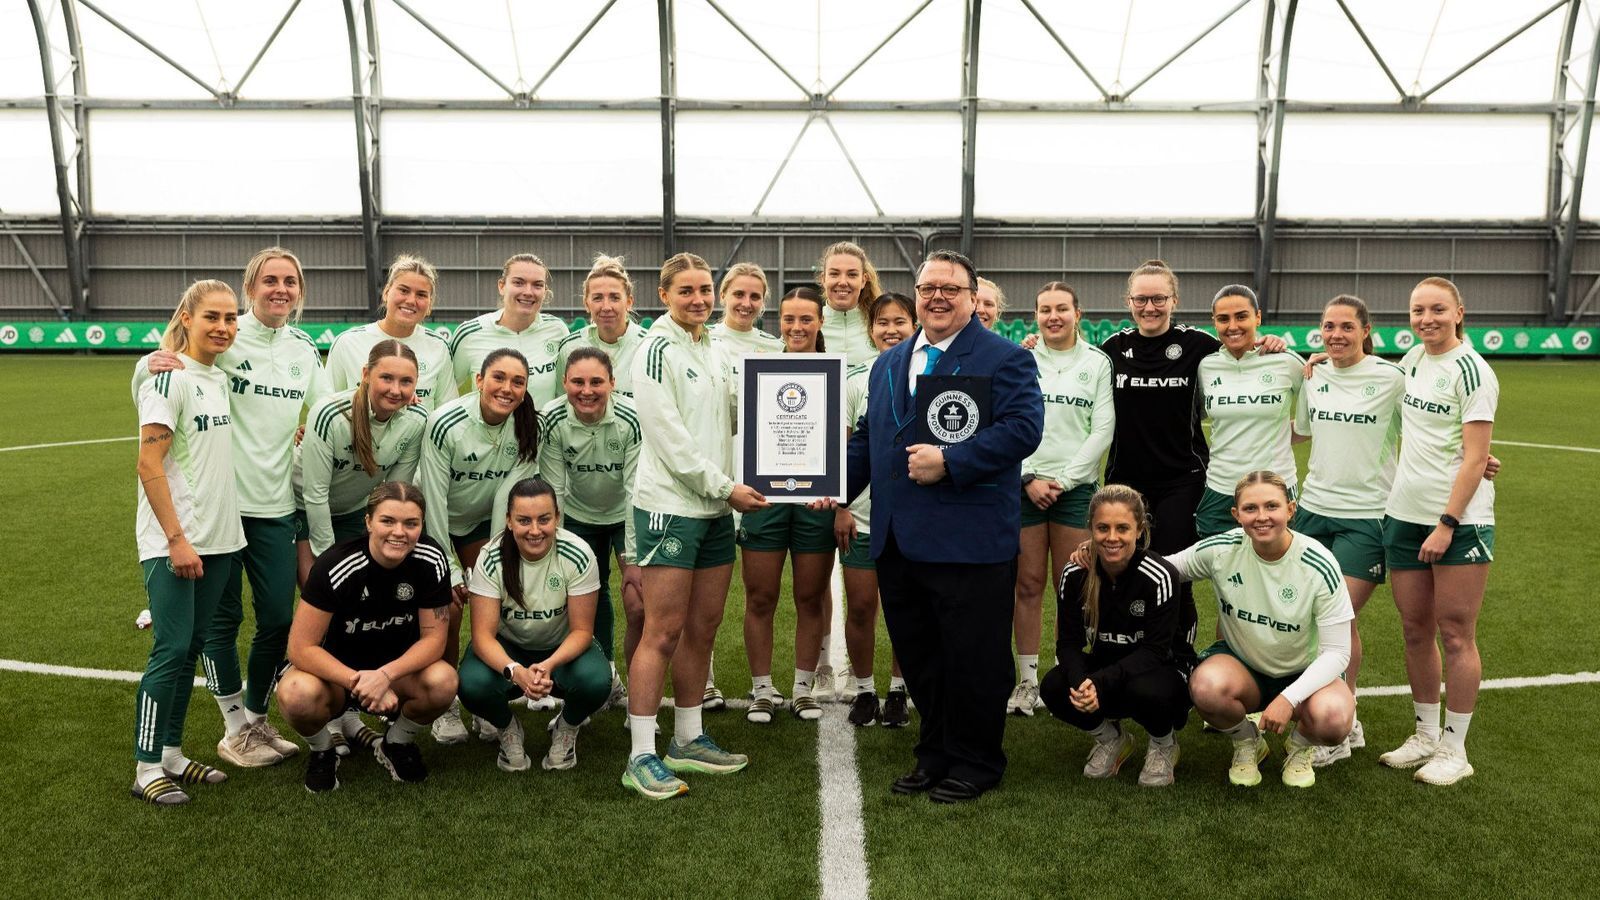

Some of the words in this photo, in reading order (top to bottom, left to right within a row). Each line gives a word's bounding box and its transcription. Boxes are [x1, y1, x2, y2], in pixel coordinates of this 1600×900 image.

[1130, 377, 1189, 387] ELEVEN
[254, 384, 305, 400] ELEVEN
[935, 394, 972, 408] GUINNESS
[1041, 394, 1094, 409] ELEVEN
[1218, 395, 1282, 405] ELEVEN
[1403, 393, 1451, 415] ELEVEN
[212, 415, 232, 426] ELEV
[1318, 411, 1377, 424] ELEVEN
[931, 413, 948, 438] WORLD
[949, 413, 976, 439] RECORDS
[577, 463, 624, 473] ELEVE
[514, 605, 566, 620] ELEVE
[1237, 609, 1300, 632] ELEVEN
[1099, 630, 1144, 644] ELEVE
